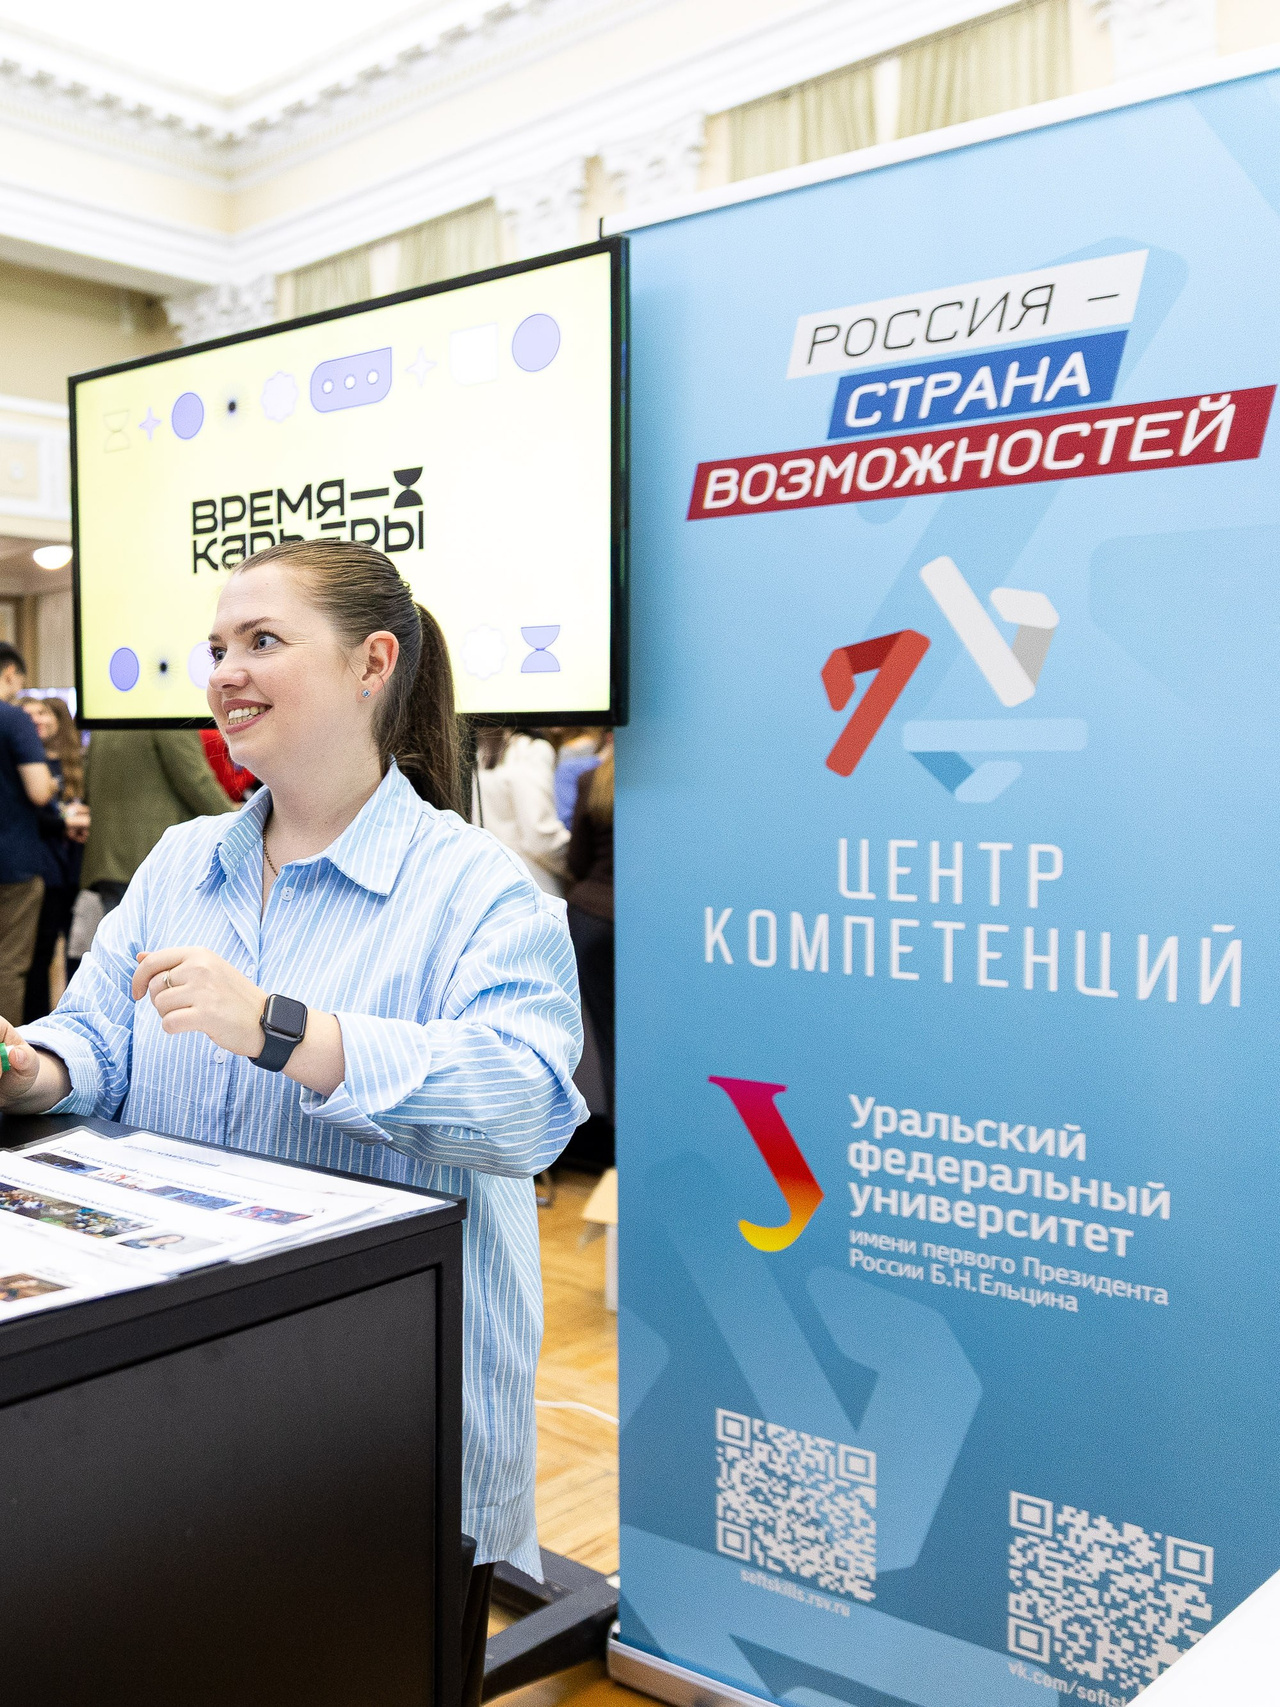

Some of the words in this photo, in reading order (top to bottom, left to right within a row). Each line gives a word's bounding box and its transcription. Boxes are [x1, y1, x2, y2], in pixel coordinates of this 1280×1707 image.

[806, 283, 1056, 365] РОССИЯ
[844, 350, 1092, 429] СТРАНА
[701, 392, 1238, 511] ВОЗМОЖНОСТЕЙ
[837, 837, 1064, 909] ЦЕНТР
[703, 905, 1244, 1008] КОМПЕТЕНЦИЙ
[848, 1093, 1087, 1162] Уральский
[847, 1139, 1173, 1221] федеральный
[848, 1182, 1135, 1258] университет
[849, 1247, 924, 1282] России
[849, 1229, 917, 1256] имени
[922, 1241, 1017, 1275] первого
[1022, 1255, 1170, 1307] Президента
